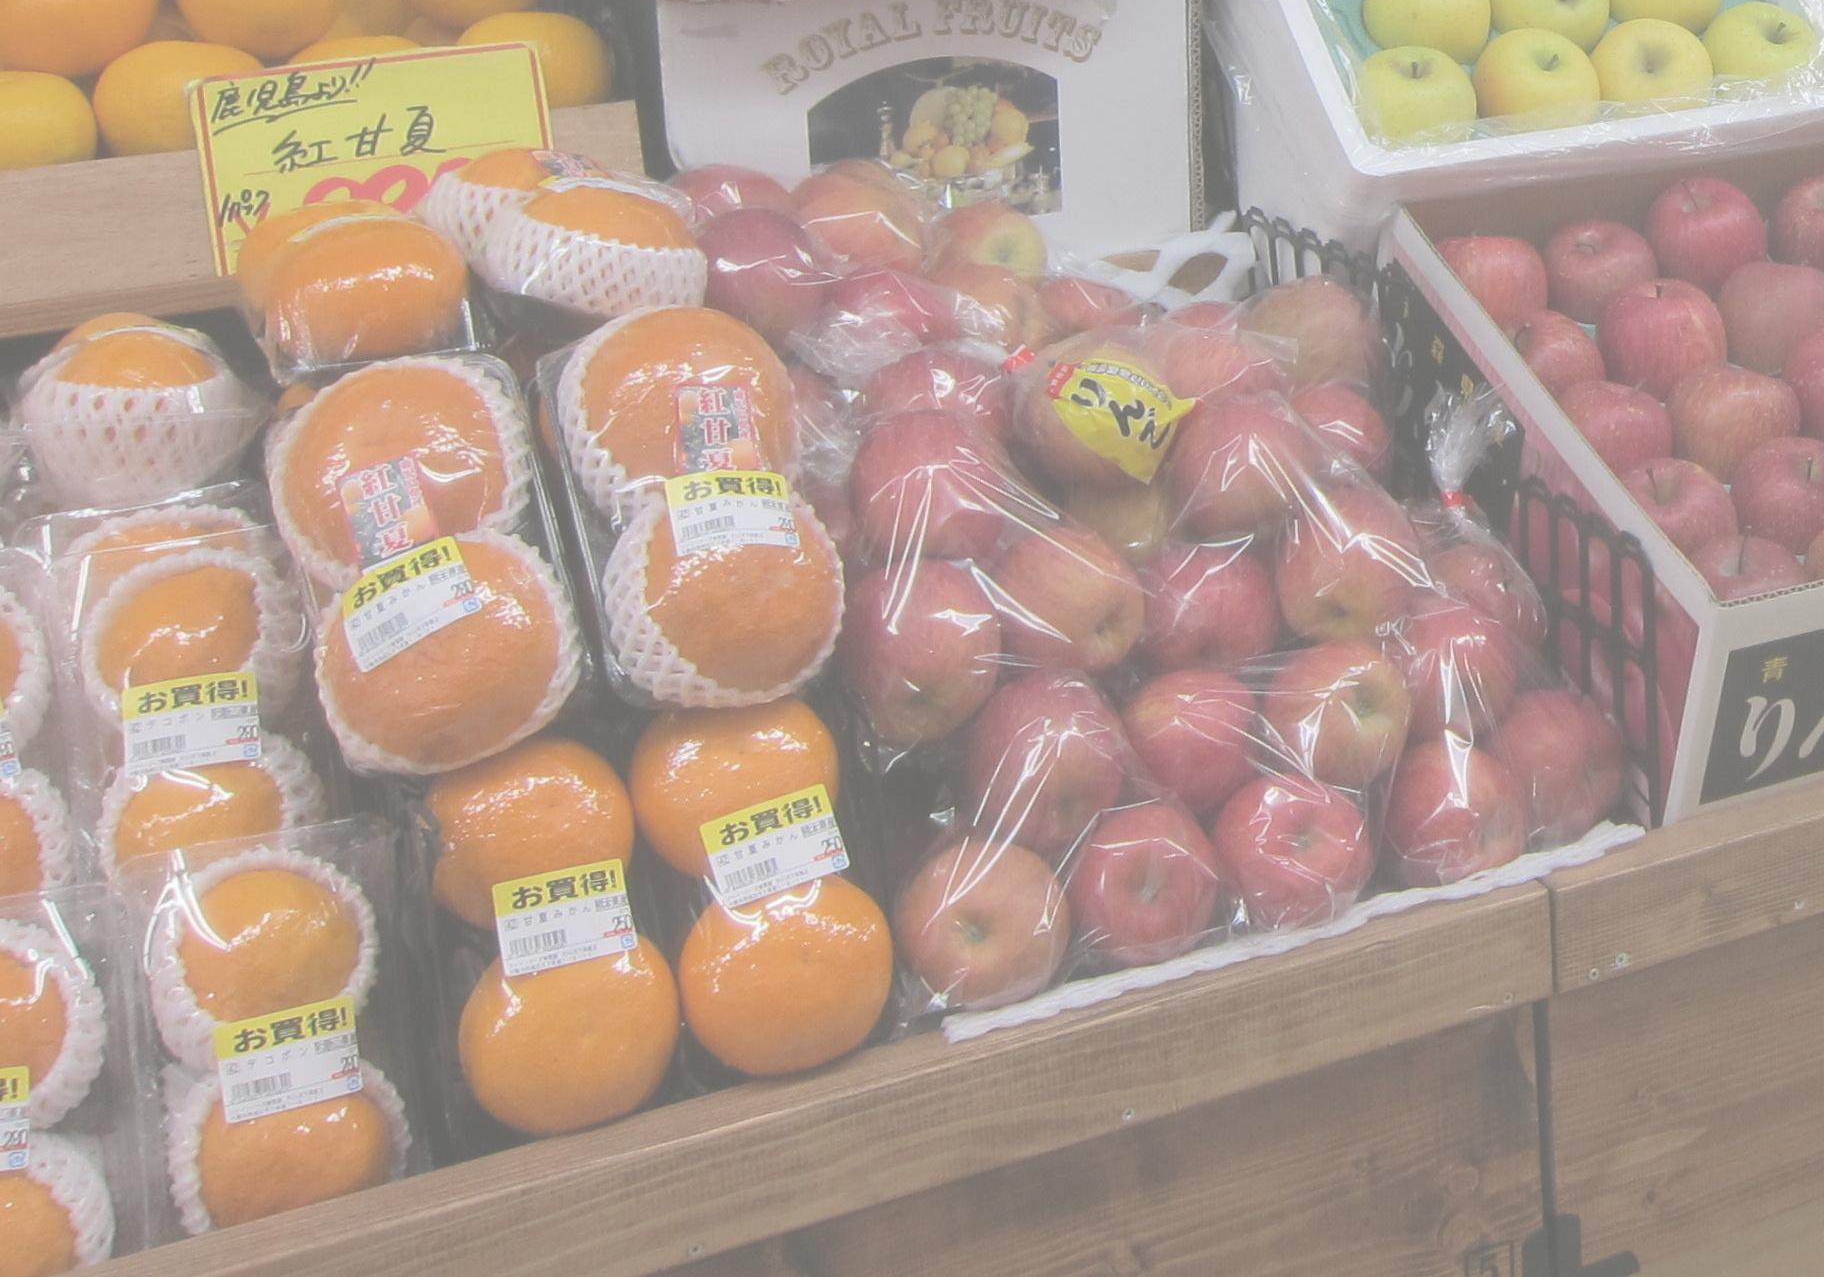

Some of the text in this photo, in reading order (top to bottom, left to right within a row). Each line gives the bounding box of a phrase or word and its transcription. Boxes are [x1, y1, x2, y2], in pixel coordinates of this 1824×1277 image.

[759, 1, 922, 96] ROYAL
[271, 106, 447, 174] 紅甘夏
[682, 476, 782, 502] お買得!
[353, 543, 453, 610] お買得!
[137, 679, 248, 714] お買得!
[718, 794, 823, 846] お買得!
[511, 868, 617, 910] お買得!
[232, 1006, 348, 1054] お買得!
